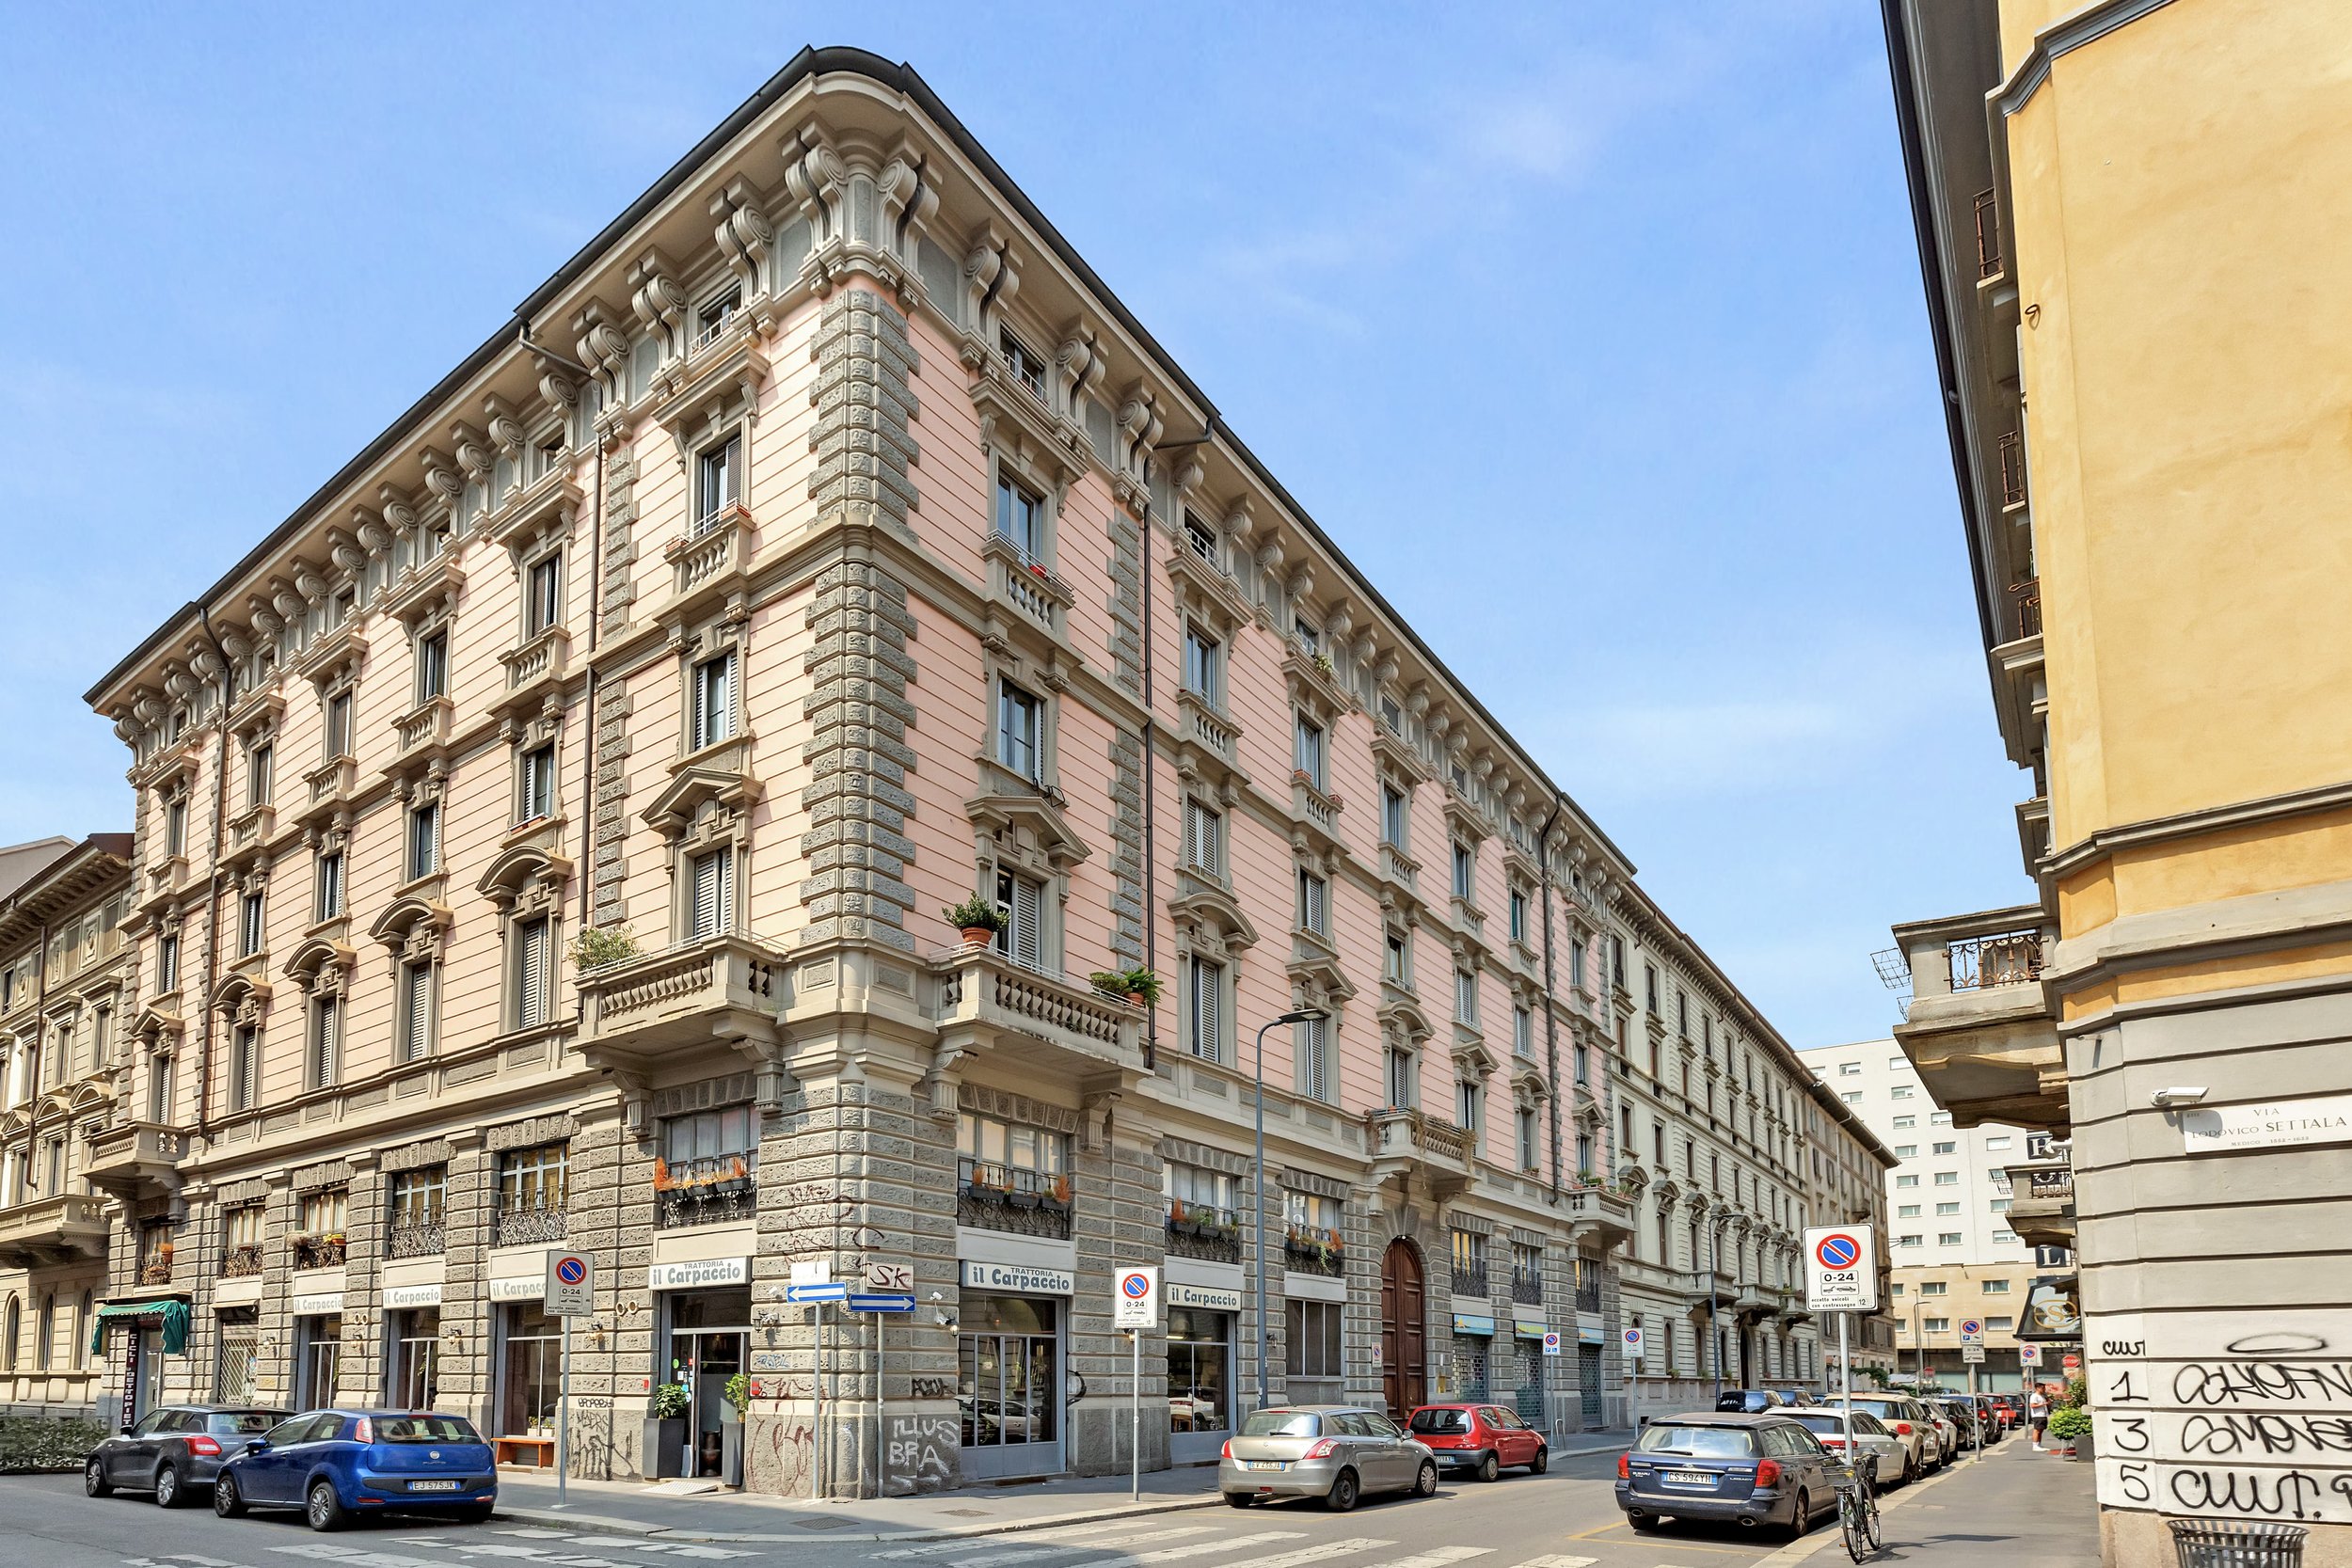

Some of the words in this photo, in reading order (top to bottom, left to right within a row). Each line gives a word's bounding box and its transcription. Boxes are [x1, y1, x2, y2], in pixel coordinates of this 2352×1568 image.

[2253, 1107, 2280, 1117] VIA
[2191, 1126, 2260, 1139] LODOVICO
[2265, 1117, 2347, 1132] SETTALA
[653, 1269, 662, 1286] il
[667, 1262, 740, 1286] Carpaccio
[684, 1260, 724, 1270] TRATTORIA
[1010, 1267, 1054, 1277] TRATTORIA
[973, 1266, 985, 1284] il
[992, 1268, 1070, 1291] Carpaccio
[1824, 1273, 1854, 1282] 0-24
[385, 1291, 391, 1305] il
[393, 1289, 439, 1307] Carpaccio
[492, 1282, 500, 1298] il
[1171, 1287, 1180, 1301] il
[1184, 1289, 1237, 1307] Carpaccio
[294, 1297, 300, 1311] il
[302, 1296, 342, 1313] Carpaccio
[128, 1333, 137, 1363] CICLI
[2110, 1370, 2149, 1402] 1
[2111, 1418, 2149, 1451] 3
[1668, 1472, 1679, 1481] CS
[2120, 1464, 2150, 1502] 5
